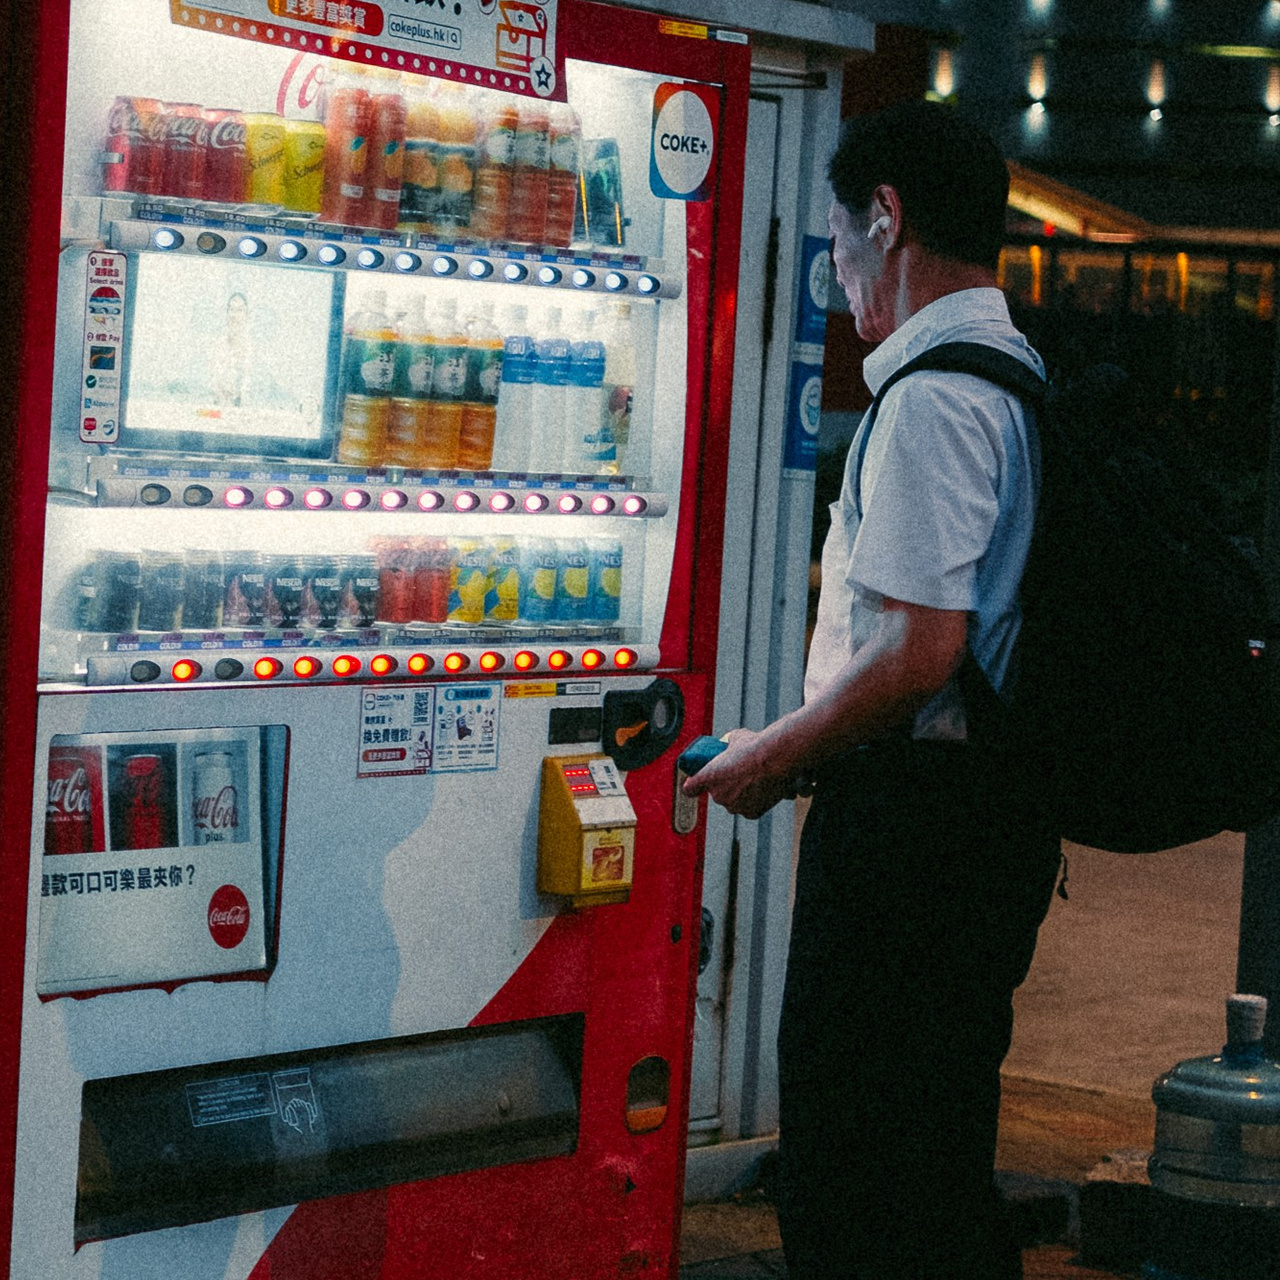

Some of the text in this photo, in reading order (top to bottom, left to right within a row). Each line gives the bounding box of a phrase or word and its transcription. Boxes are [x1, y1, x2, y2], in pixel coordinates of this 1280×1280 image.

[389, 19, 446, 43] cokeplus.hk
[659, 132, 709, 155] COKE+
[209, 905, 248, 927] Coca-Cola
